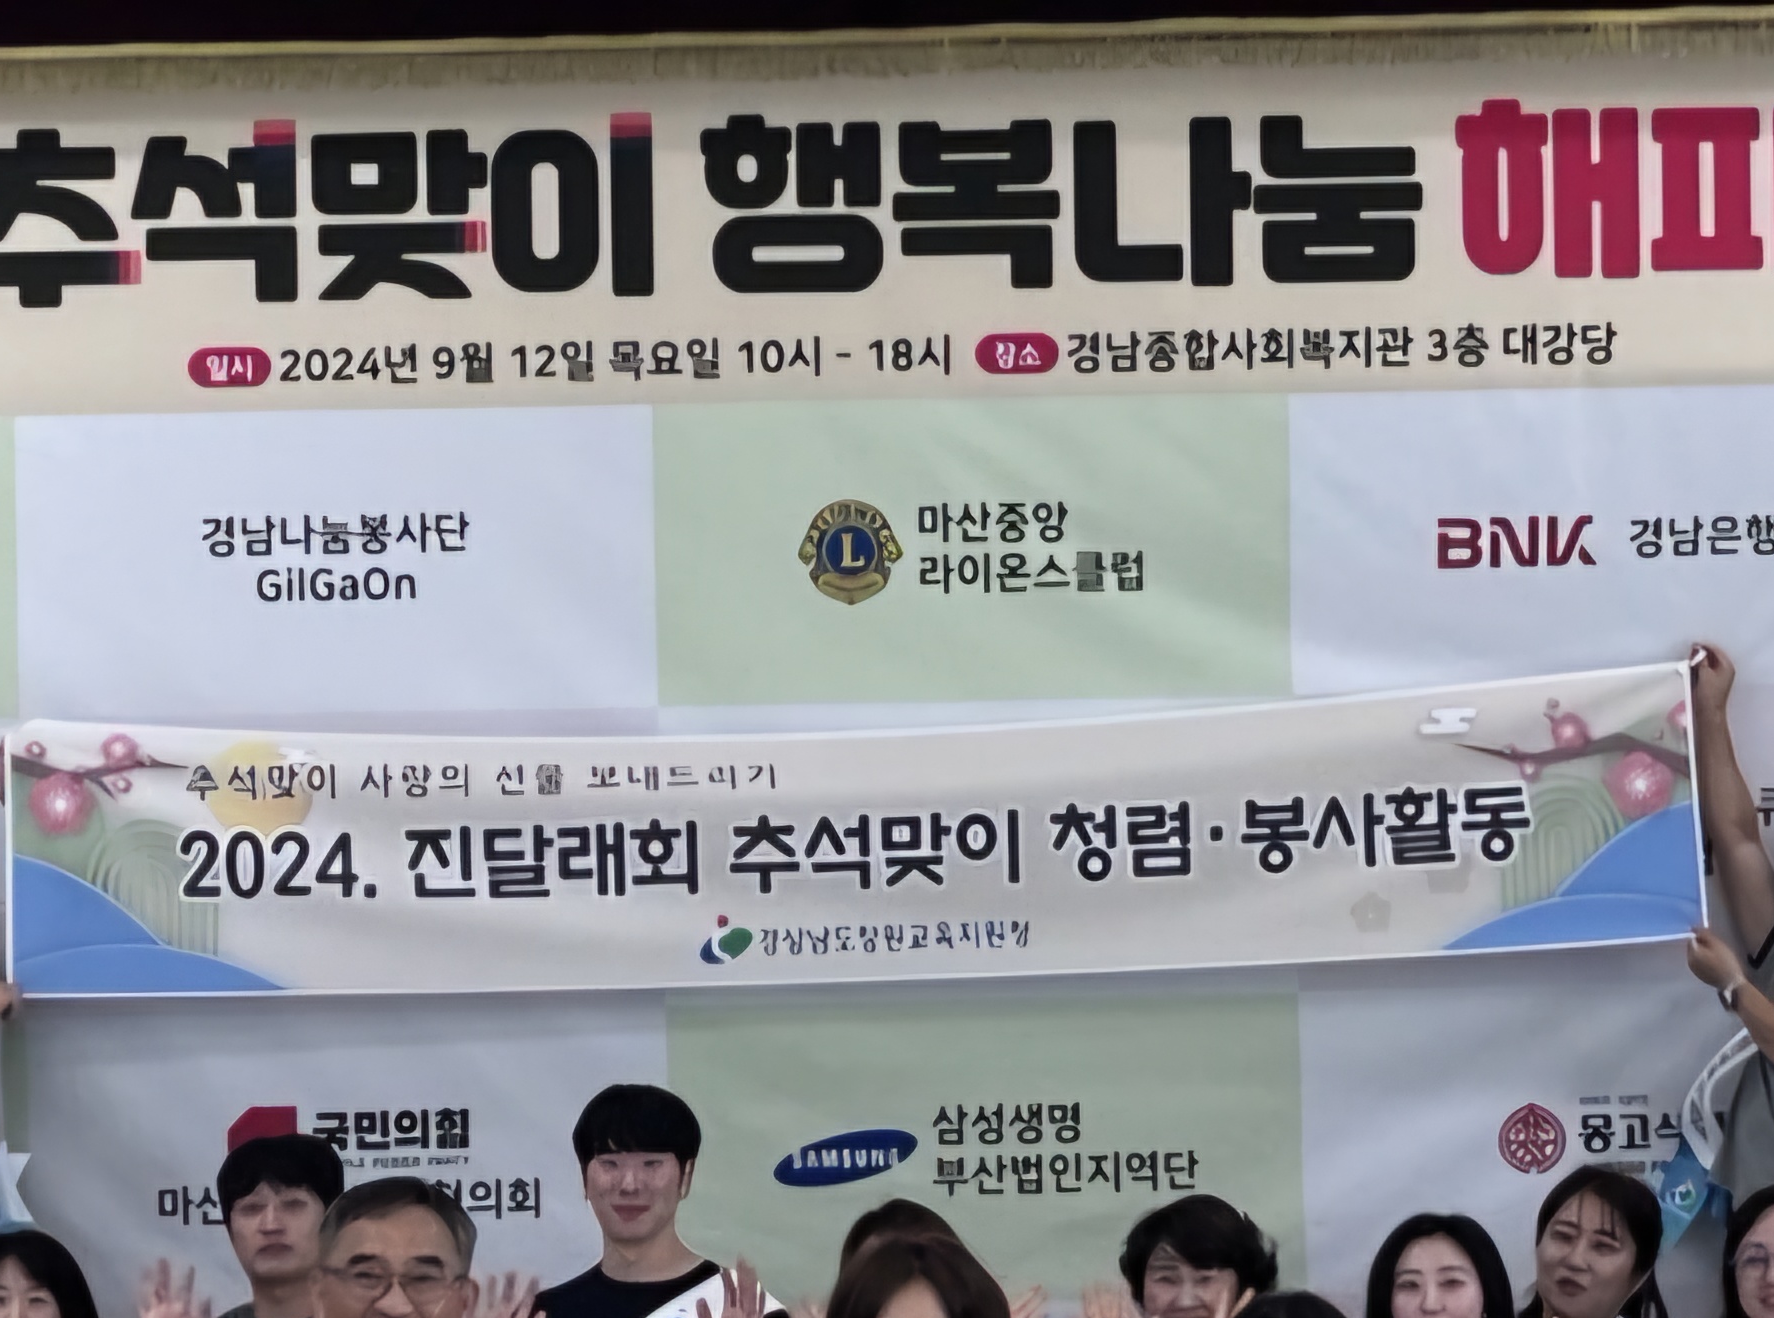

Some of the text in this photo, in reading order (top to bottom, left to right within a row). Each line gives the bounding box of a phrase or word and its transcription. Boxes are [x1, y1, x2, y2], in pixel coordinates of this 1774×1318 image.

[699, 113, 1424, 294] 행복나눔
[279, 342, 418, 384] 2024년
[432, 341, 494, 384] 9월
[510, 340, 595, 383] 12일
[608, 337, 721, 382] 목요일
[737, 335, 821, 377] 10시
[868, 333, 951, 376] 18시
[1067, 326, 1414, 374] 경남종합사회복지관
[1427, 322, 1490, 368] 3층
[1502, 321, 1618, 366] 대강당
[201, 510, 470, 558] 경남나눔봉사단
[918, 500, 1069, 544] 마산중앙
[1437, 514, 1597, 570] BNK
[256, 566, 417, 603] GilGaOn
[180, 829, 377, 900] 2024.
[404, 818, 699, 899] 진달래회
[729, 809, 1020, 894] 추석맞이
[1049, 800, 1191, 882] 청렴
[1240, 786, 1531, 874] 봉사활동
[932, 1101, 1081, 1146] 삼성생명
[932, 1149, 1204, 1199] 부산법인지역단
[157, 1184, 227, 1226] 마산
